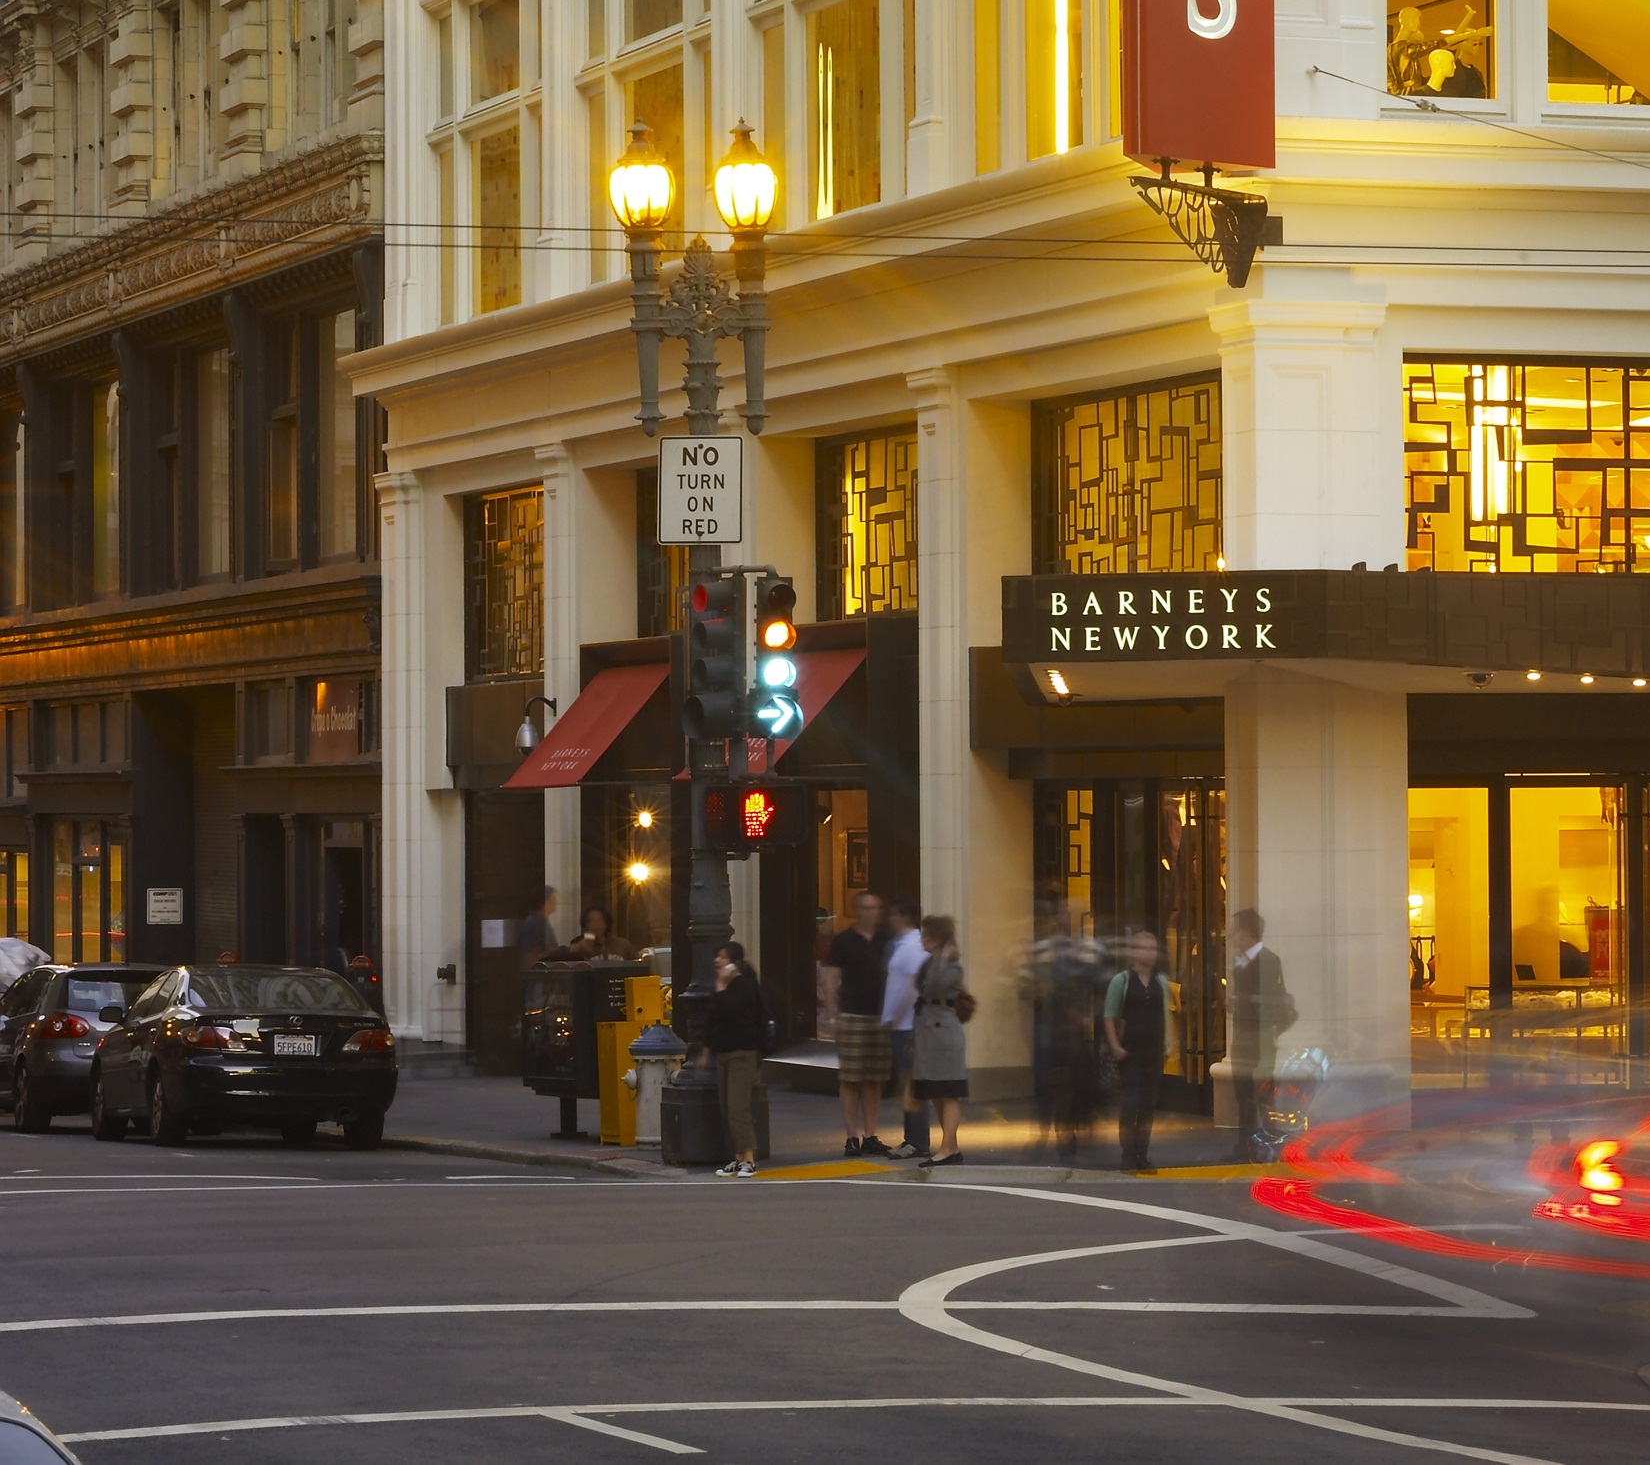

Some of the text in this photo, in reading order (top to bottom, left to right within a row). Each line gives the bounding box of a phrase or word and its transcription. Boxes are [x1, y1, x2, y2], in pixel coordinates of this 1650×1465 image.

[682, 446, 719, 467] NO
[676, 473, 725, 490] TURN
[687, 496, 714, 512] ON
[682, 518, 718, 535] RED
[1050, 587, 1272, 616] BARNEYS
